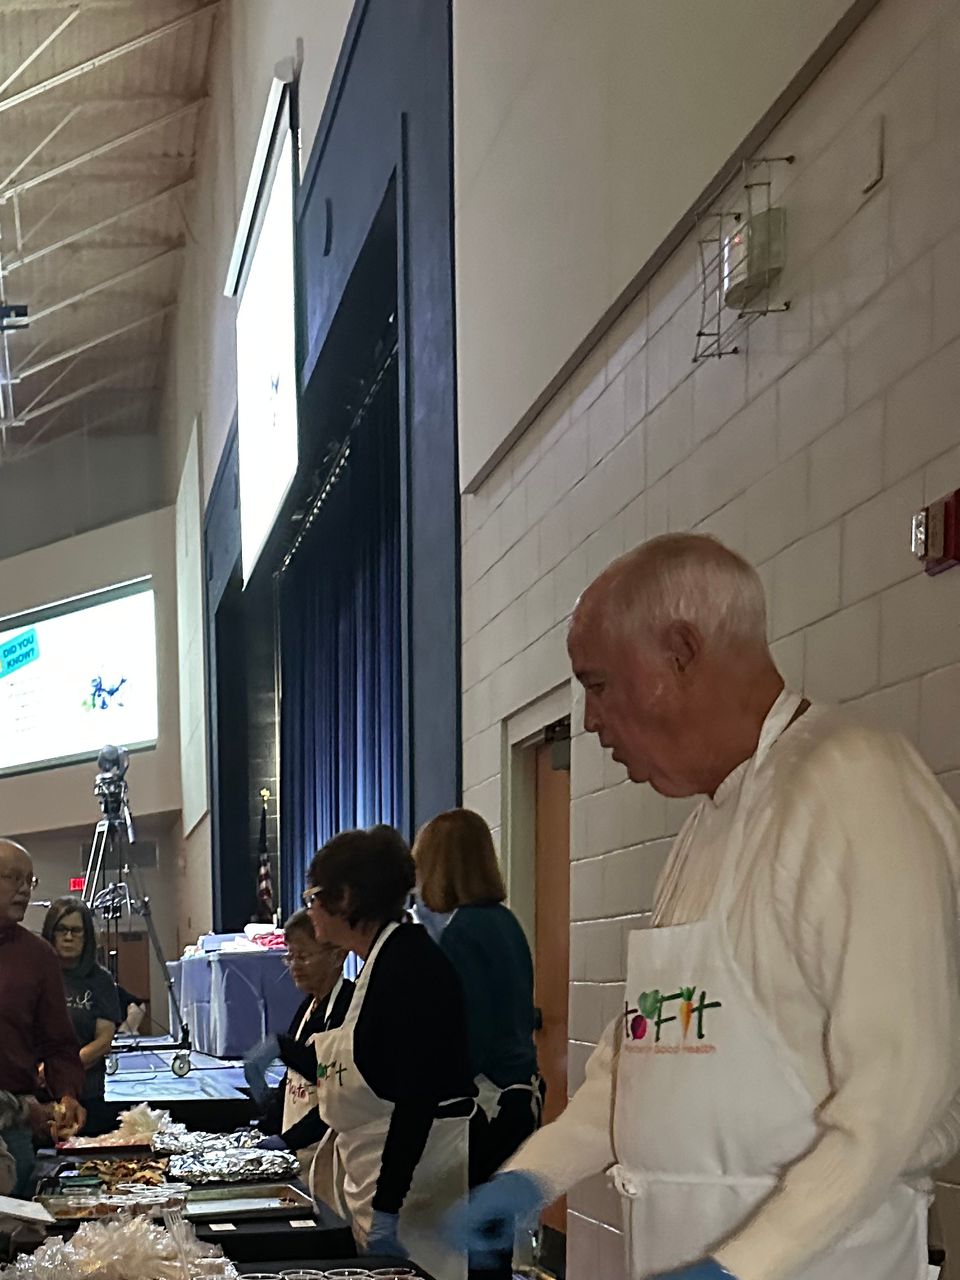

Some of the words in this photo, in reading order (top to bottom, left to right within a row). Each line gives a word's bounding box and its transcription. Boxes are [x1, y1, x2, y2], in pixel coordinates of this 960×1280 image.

[3, 645, 17, 658] DID
[18, 634, 34, 651] YOU
[7, 647, 35, 669] KNOW?
